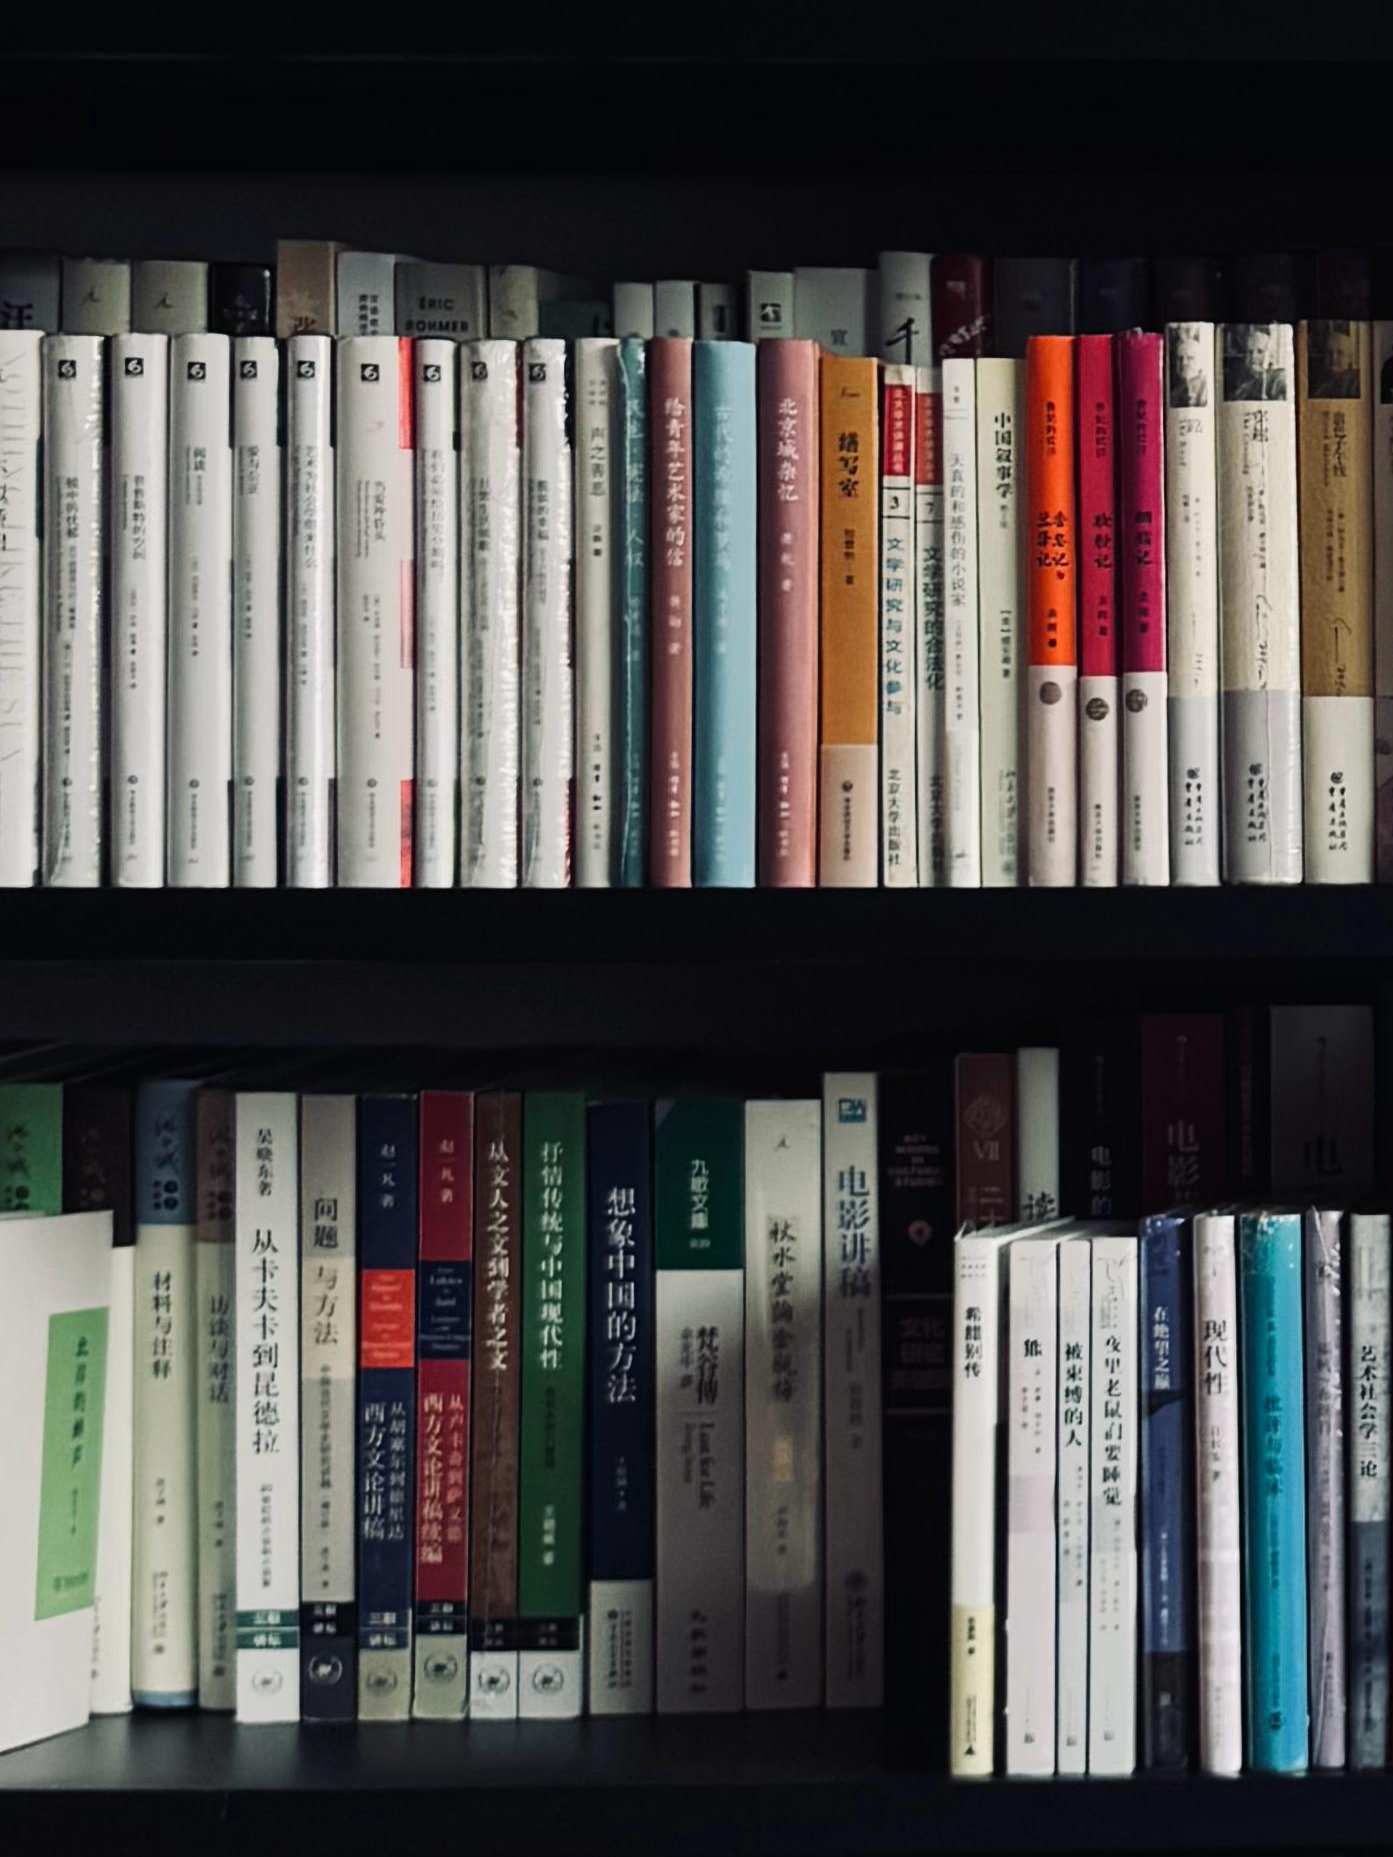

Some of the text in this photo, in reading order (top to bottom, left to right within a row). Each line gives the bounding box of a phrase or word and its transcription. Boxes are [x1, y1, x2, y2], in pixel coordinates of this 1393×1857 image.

[776, 397, 799, 503] 北京城杂记
[838, 432, 860, 502] 缮写室
[539, 1143, 563, 1371] 抒情传统与中国现代性
[838, 1165, 872, 1299] 电影讲稿
[151, 1271, 173, 1381] 材料与注释
[251, 1229, 281, 1455] 从卡夫卡到昆德拉
[606, 1187, 637, 1404] 想象中国的方法
[1203, 1320, 1230, 1396] 现代性
